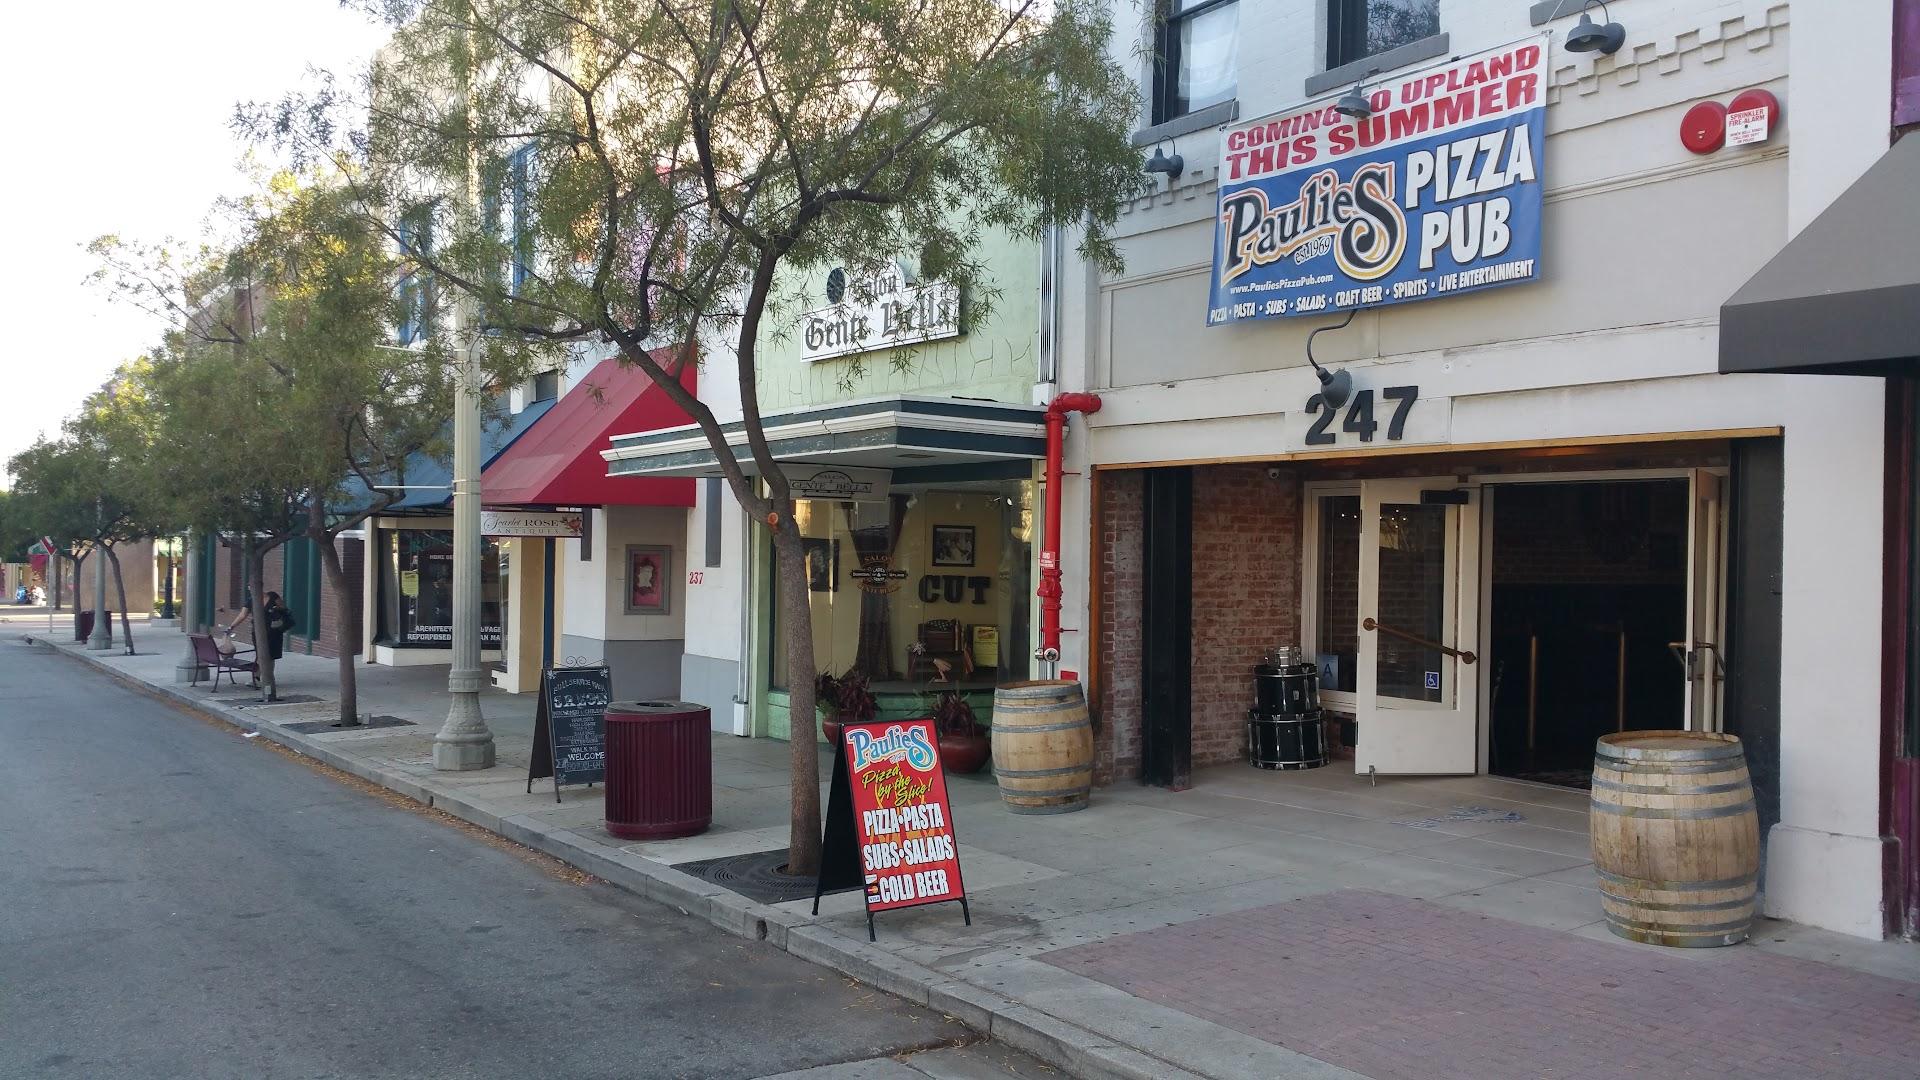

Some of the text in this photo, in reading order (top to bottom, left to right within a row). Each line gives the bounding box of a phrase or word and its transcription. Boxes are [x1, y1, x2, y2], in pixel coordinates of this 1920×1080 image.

[1227, 105, 1342, 150] COMING
[1401, 45, 1540, 104] UPLAND
[1226, 73, 1538, 179] THIS SUMMER
[1730, 109, 1764, 121] SPRINKLER
[1405, 124, 1535, 208] PIZZA
[1419, 197, 1511, 269] PUB
[1210, 259, 1535, 323] PIZZA PASTA SUBS SALADS CRAFT BEER SPIRITS LIVE ENTERTAINMENT
[1230, 274, 1334, 295] www.PauliesPizzaPub.com
[1305, 386, 1419, 445] 247
[524, 519, 559, 527] ROSE
[689, 571, 704, 584] 237
[918, 574, 991, 604] CUT
[407, 633, 452, 641] REPURPOSED
[1322, 663, 1333, 677] A
[568, 751, 606, 760] WELCOME
[862, 764, 900, 789] Pizza
[877, 775, 912, 799] by the
[863, 803, 945, 836] PIZZA PASTA
[863, 834, 954, 871] SUBS SALADS
[880, 869, 949, 903] COLD BEER
